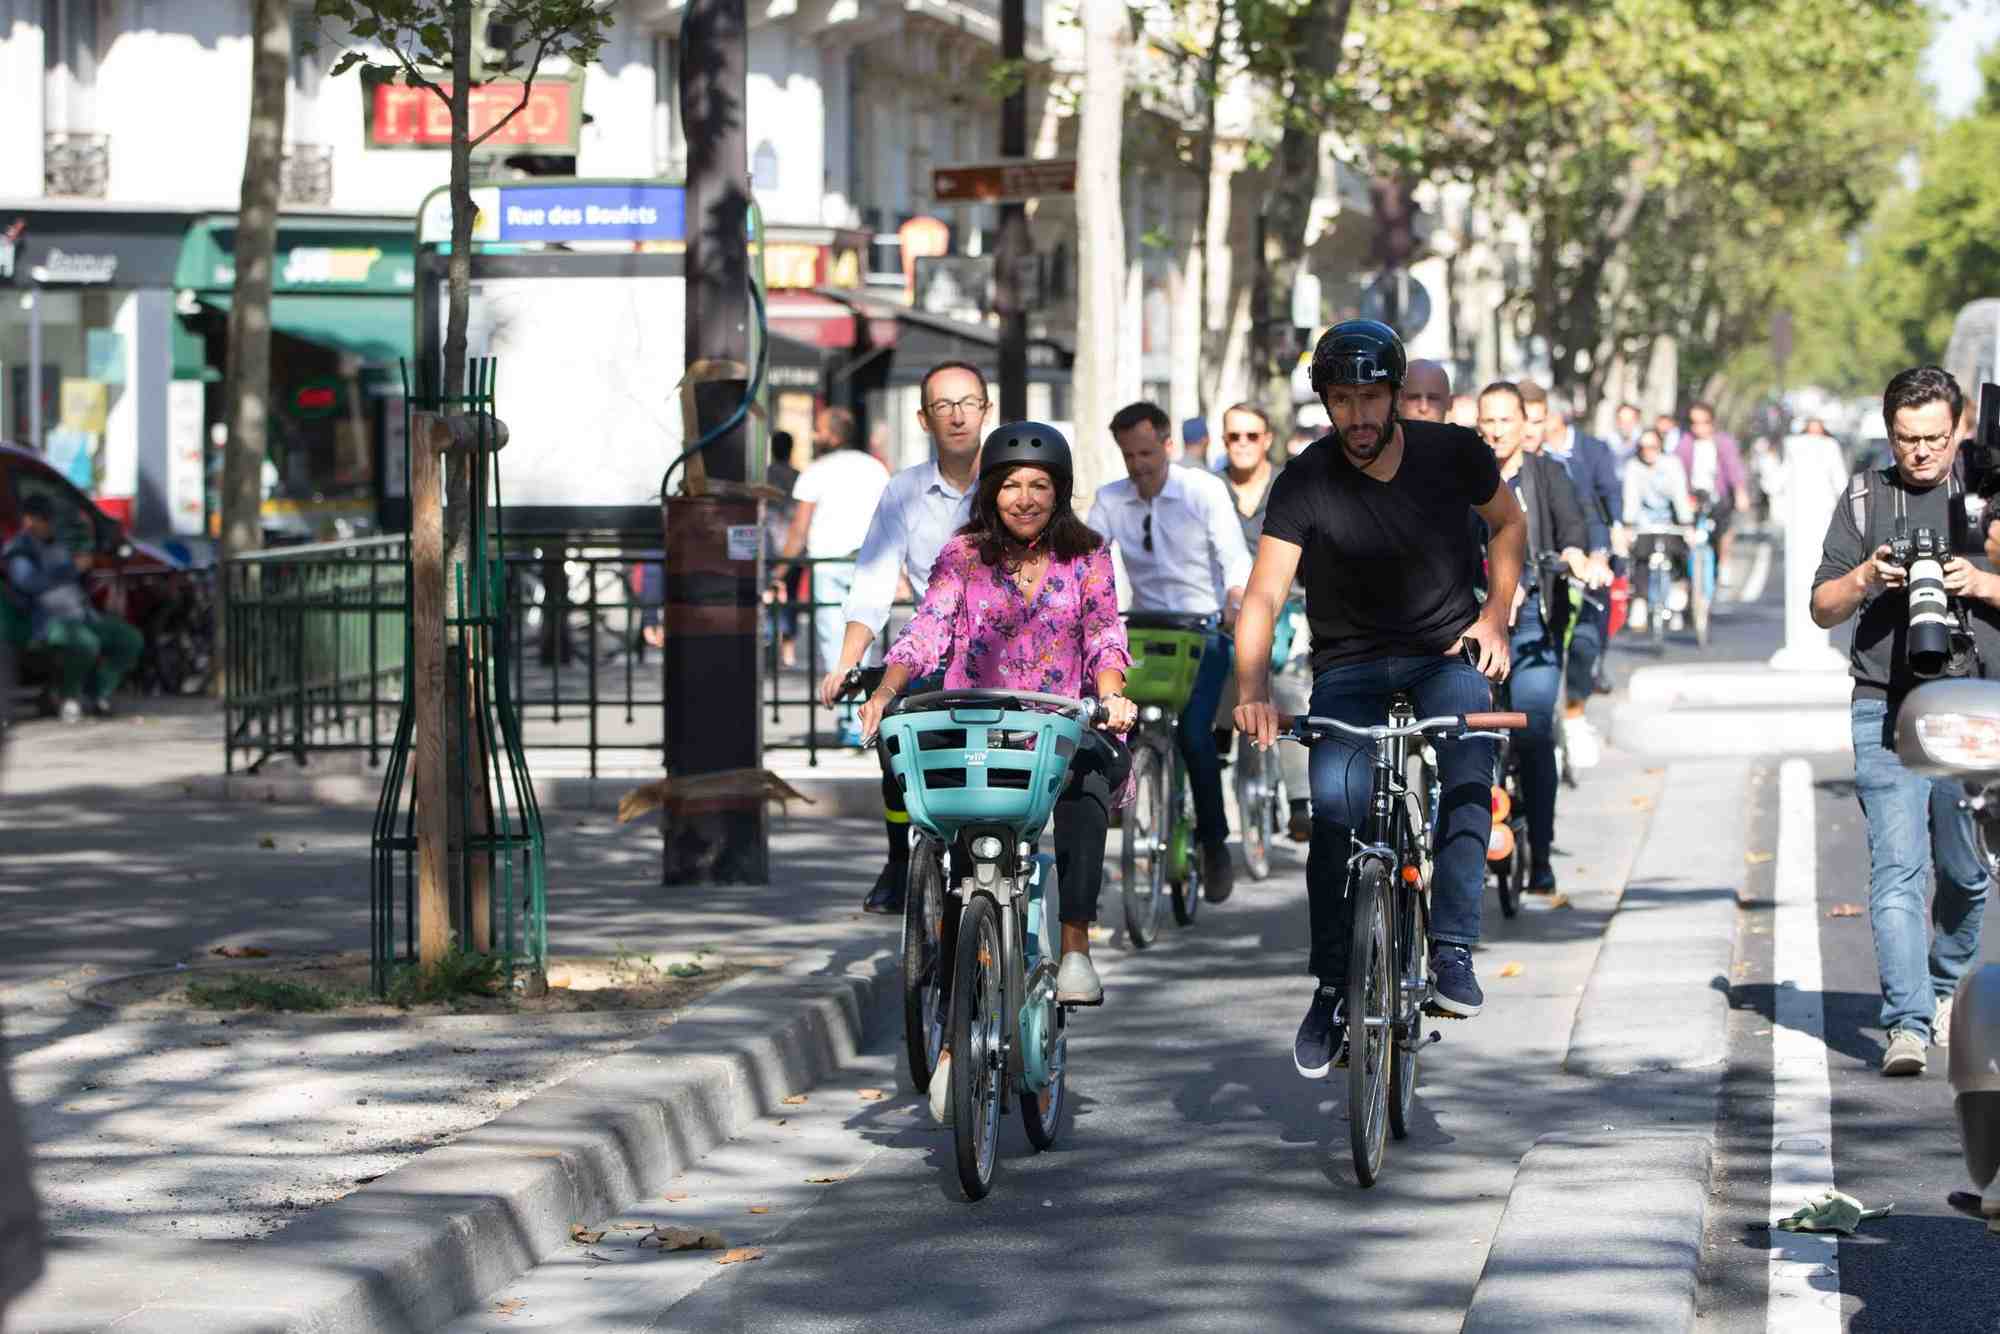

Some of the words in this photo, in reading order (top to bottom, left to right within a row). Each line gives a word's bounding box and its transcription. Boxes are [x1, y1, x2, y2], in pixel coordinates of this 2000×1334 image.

[506, 204, 545, 226] Rue
[547, 204, 583, 226] des
[585, 204, 658, 226] Boulets
